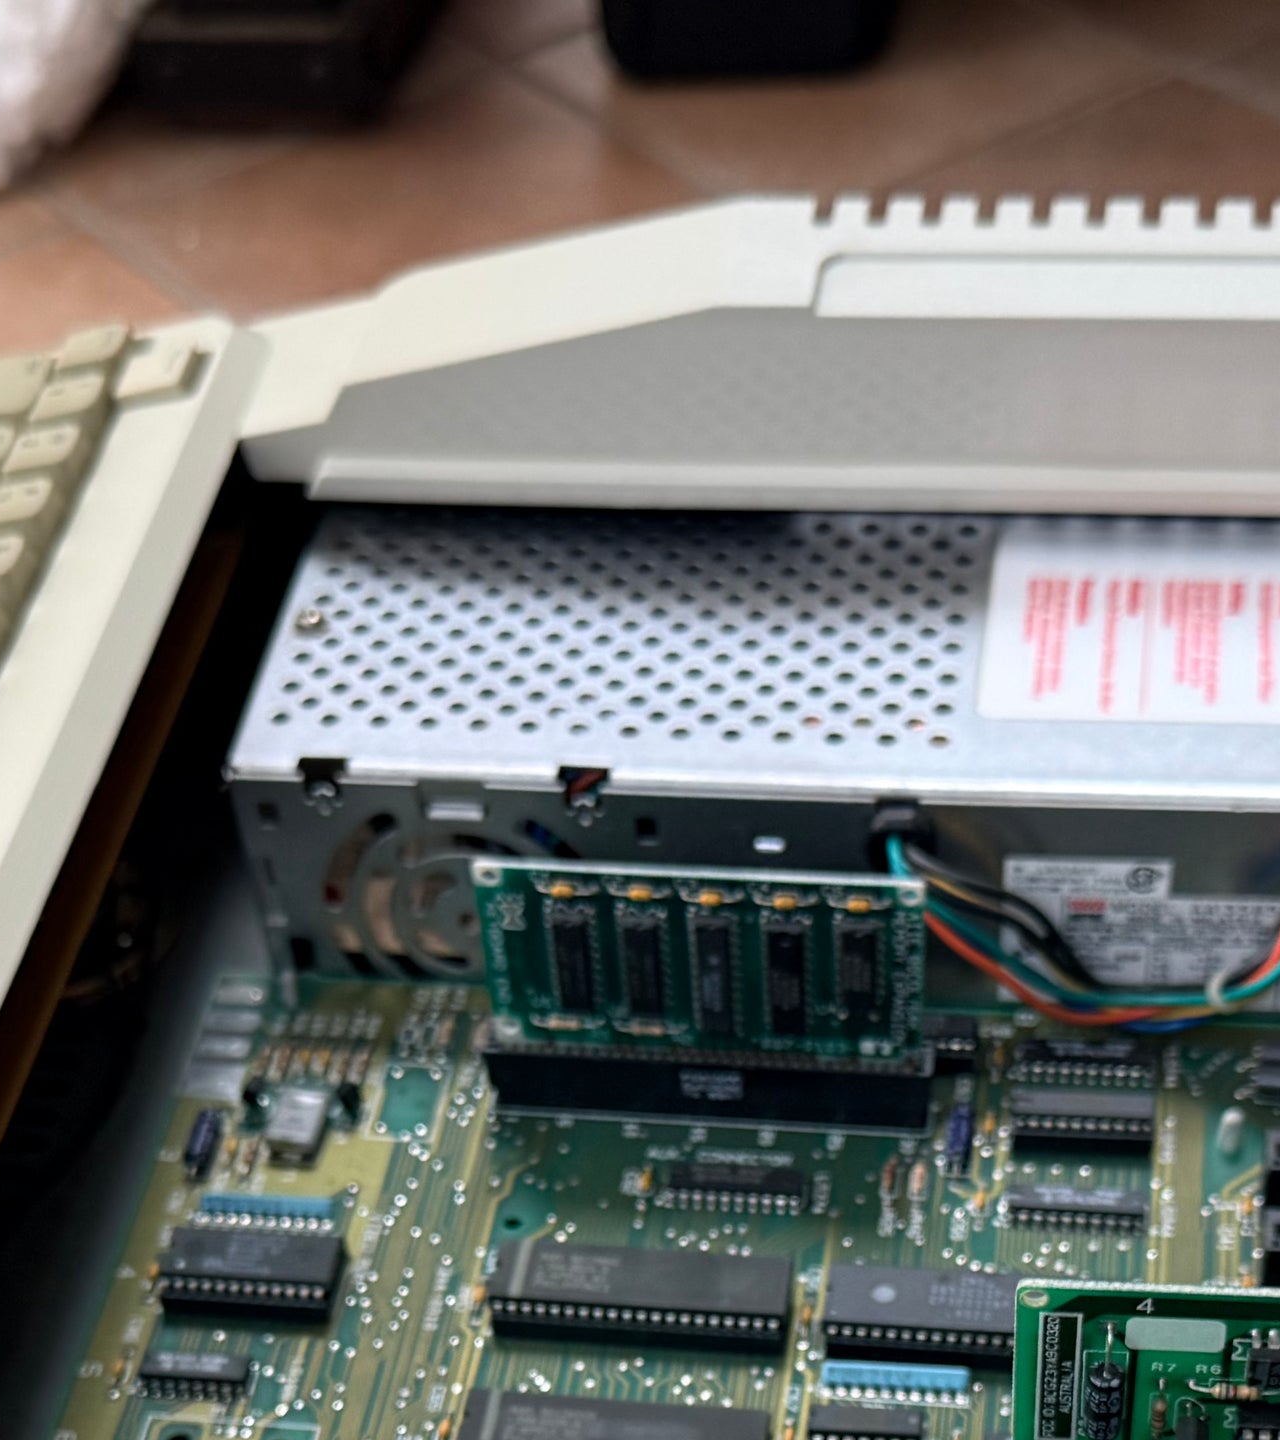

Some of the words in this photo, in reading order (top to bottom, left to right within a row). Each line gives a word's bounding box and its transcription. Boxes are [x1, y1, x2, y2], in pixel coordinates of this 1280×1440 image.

[1135, 1297, 1156, 1315] 4
[1150, 1362, 1178, 1374] R7
[1194, 1363, 1223, 1376] R6
[1056, 1360, 1074, 1415] AUSTRALIA
